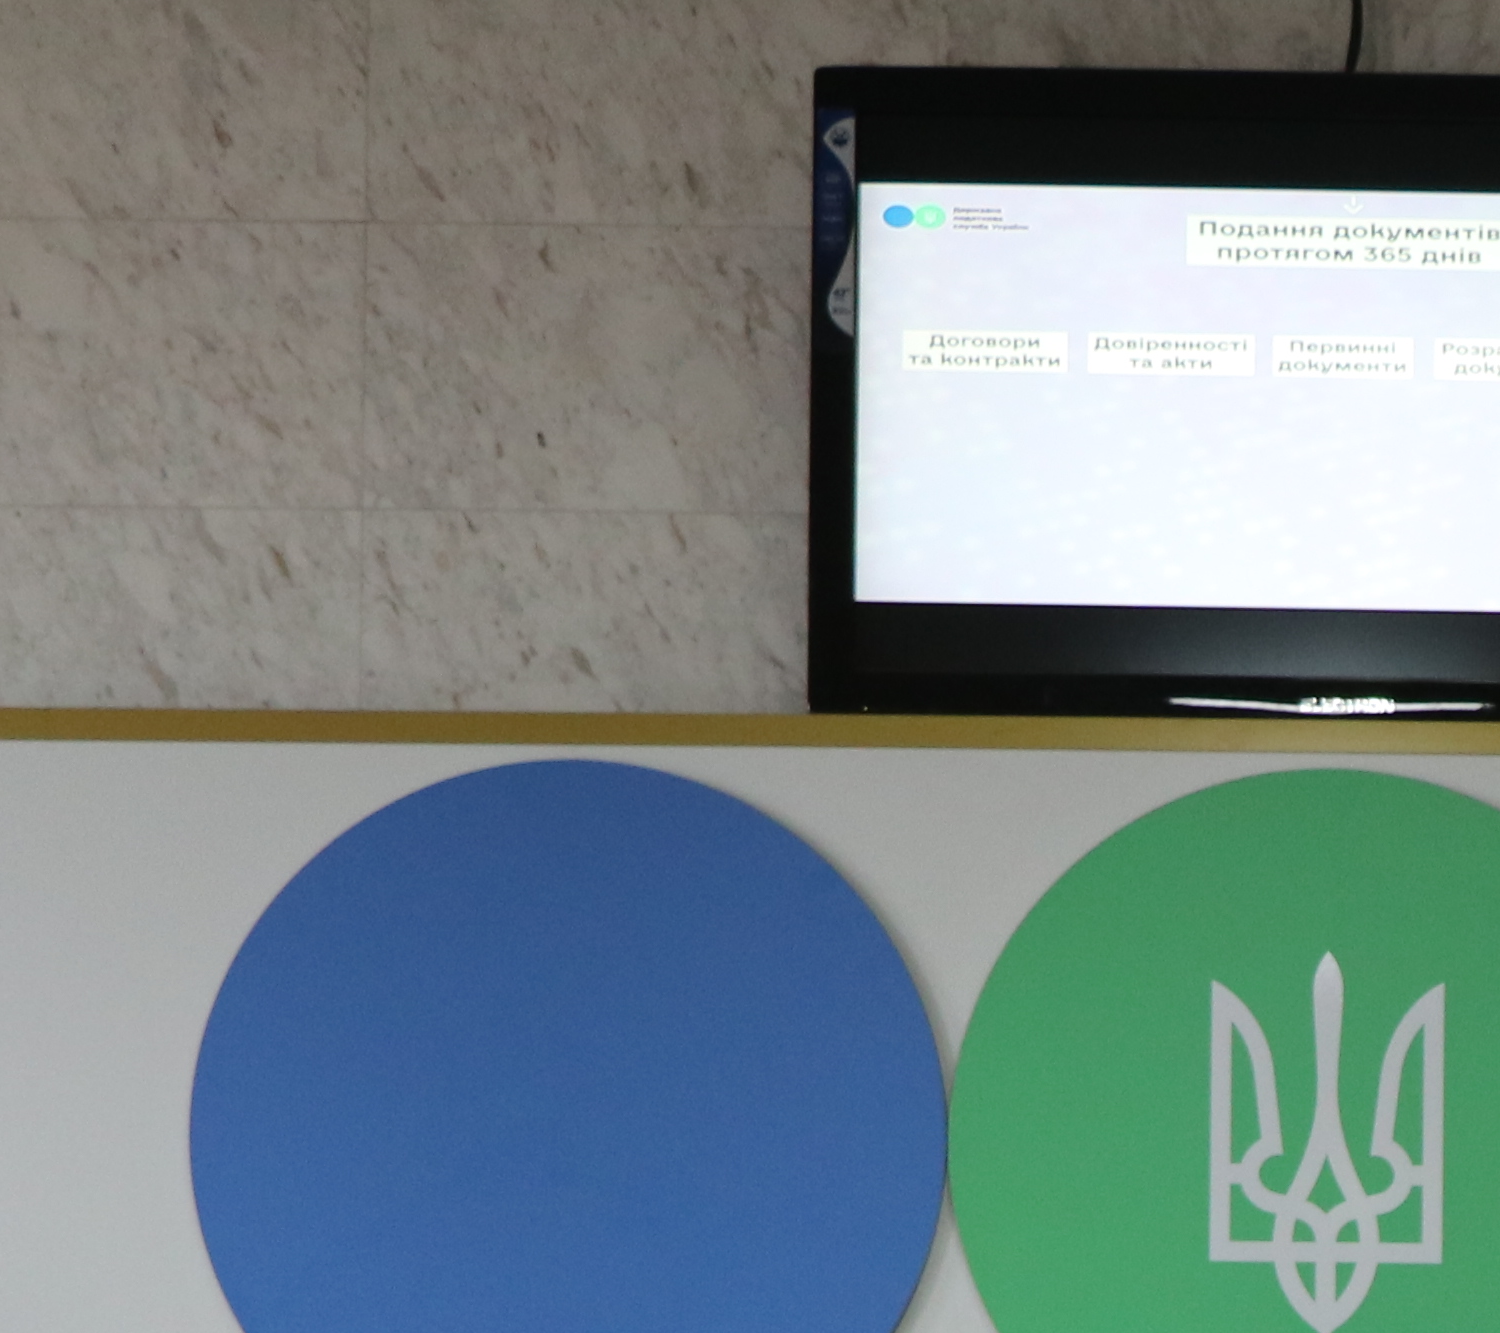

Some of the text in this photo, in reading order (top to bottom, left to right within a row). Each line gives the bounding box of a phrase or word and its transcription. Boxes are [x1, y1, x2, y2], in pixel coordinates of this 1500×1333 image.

[1199, 219, 1323, 242] Подання
[1216, 243, 1483, 266] протягом 365 днів
[928, 333, 1042, 351] Договори
[1093, 335, 1249, 354] Довіренності
[1288, 338, 1396, 357] Первинні
[908, 352, 1062, 370] та контракти
[1129, 356, 1213, 371] та акти
[1277, 358, 1407, 376] документи
